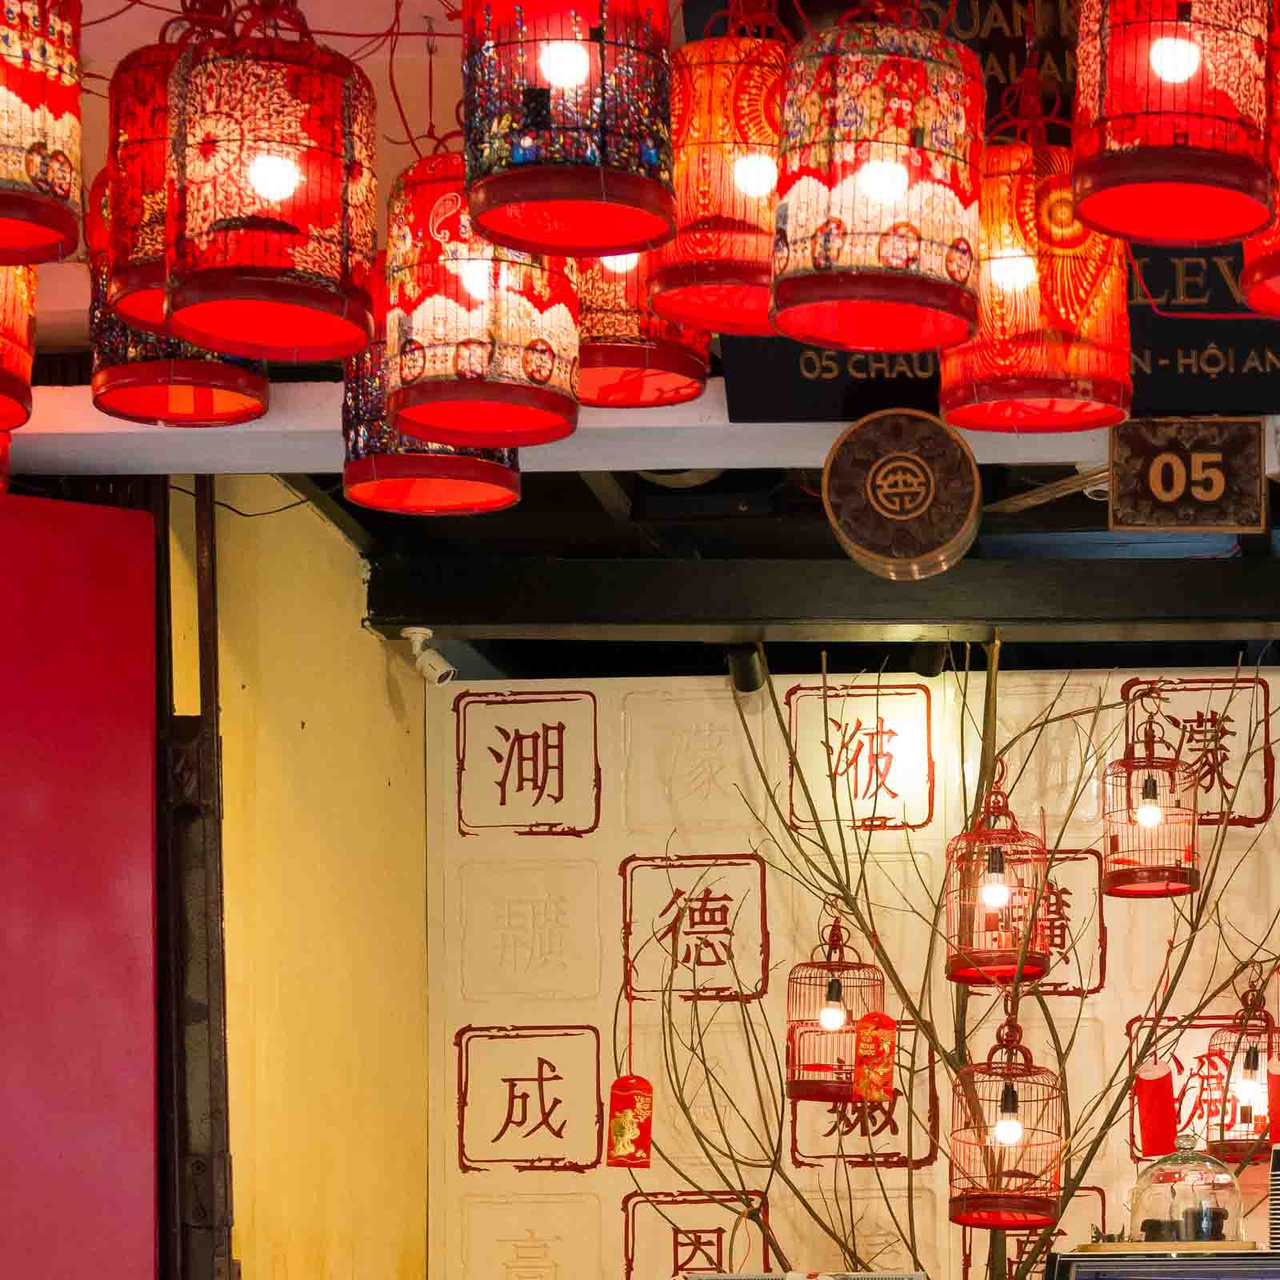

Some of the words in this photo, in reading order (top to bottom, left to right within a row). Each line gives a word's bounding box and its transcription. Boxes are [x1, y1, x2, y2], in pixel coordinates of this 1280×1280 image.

[800, 350, 840, 380] 05
[1177, 342, 1235, 380] HỘI
[1149, 451, 1225, 502] 05
[491, 1056, 569, 1143] 成
